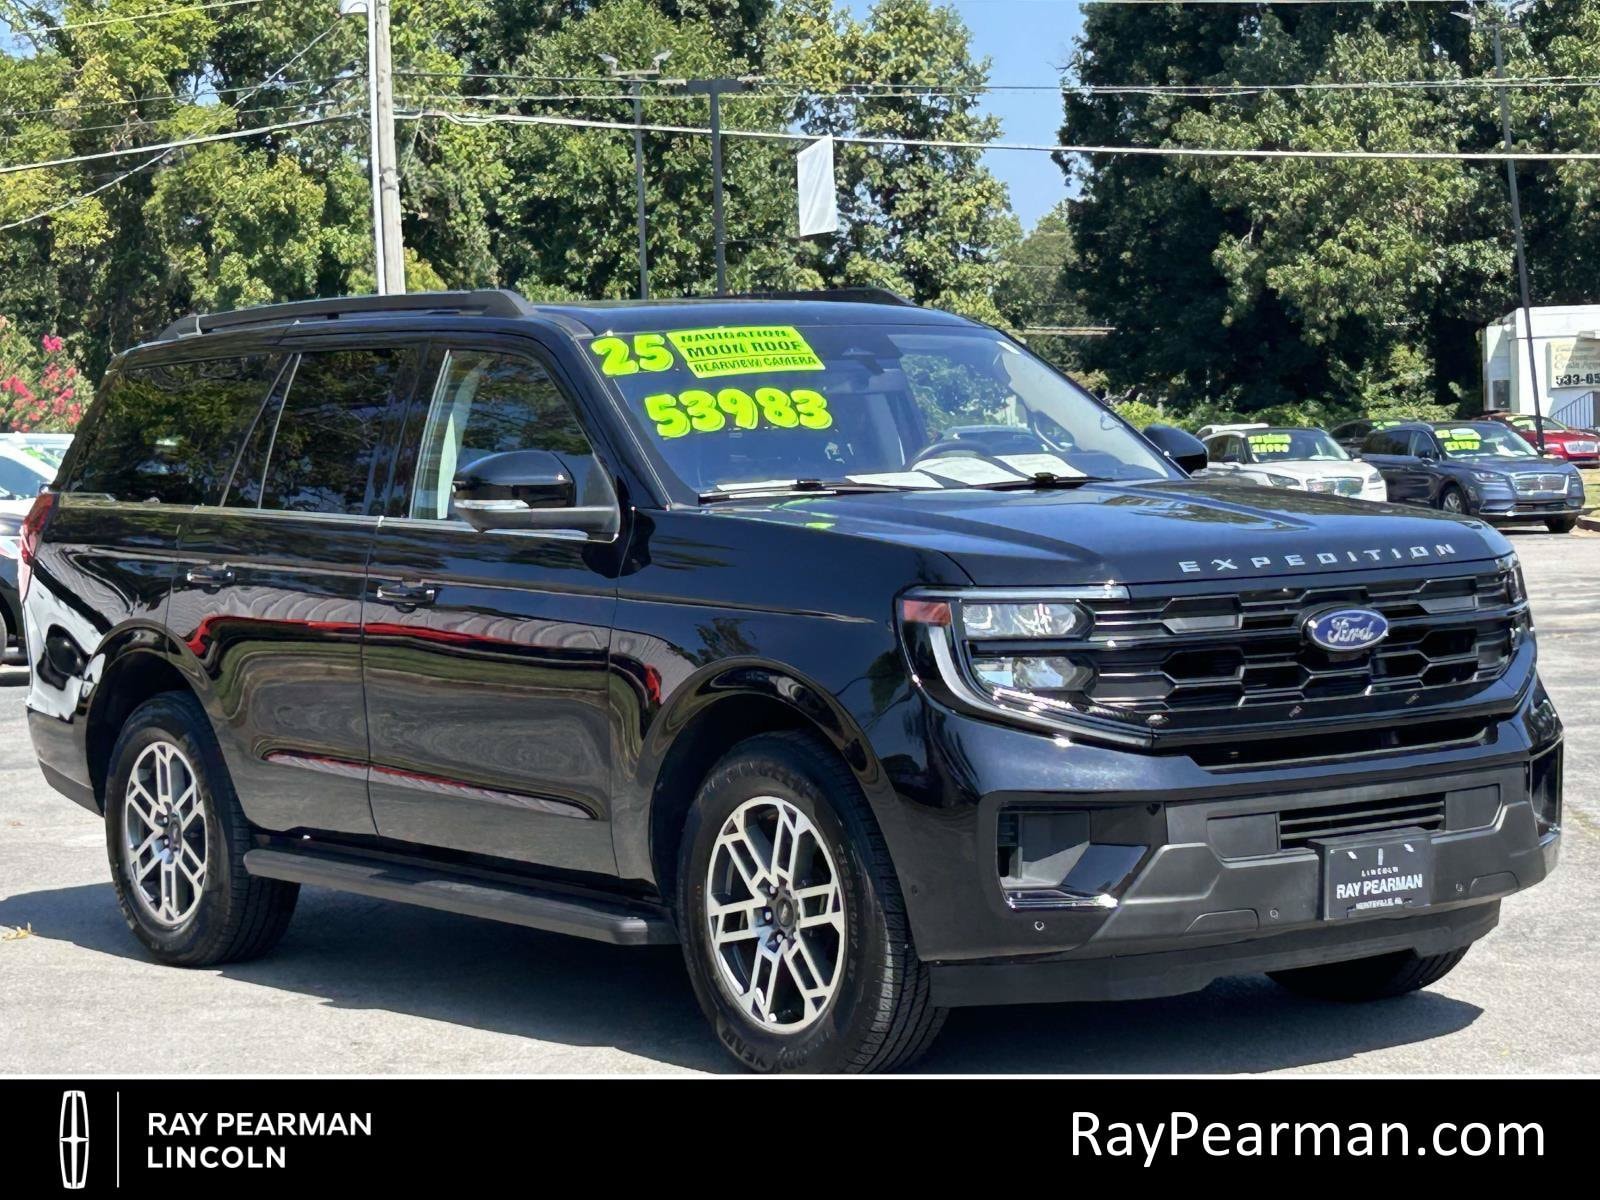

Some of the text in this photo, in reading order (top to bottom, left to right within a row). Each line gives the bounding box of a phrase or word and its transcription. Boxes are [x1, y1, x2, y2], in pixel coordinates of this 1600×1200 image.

[680, 329, 790, 343] NAVIGATION
[590, 334, 674, 376] 25
[686, 340, 801, 359] MOON ROOF
[693, 355, 818, 373] REARVIEW CAMERA
[644, 387, 832, 438] 53983
[1178, 543, 1457, 573] EXPEDITION
[1326, 616, 1375, 645] Ford
[1361, 866, 1399, 877] LINCOLN
[1336, 873, 1423, 899] RAY PEARMAN
